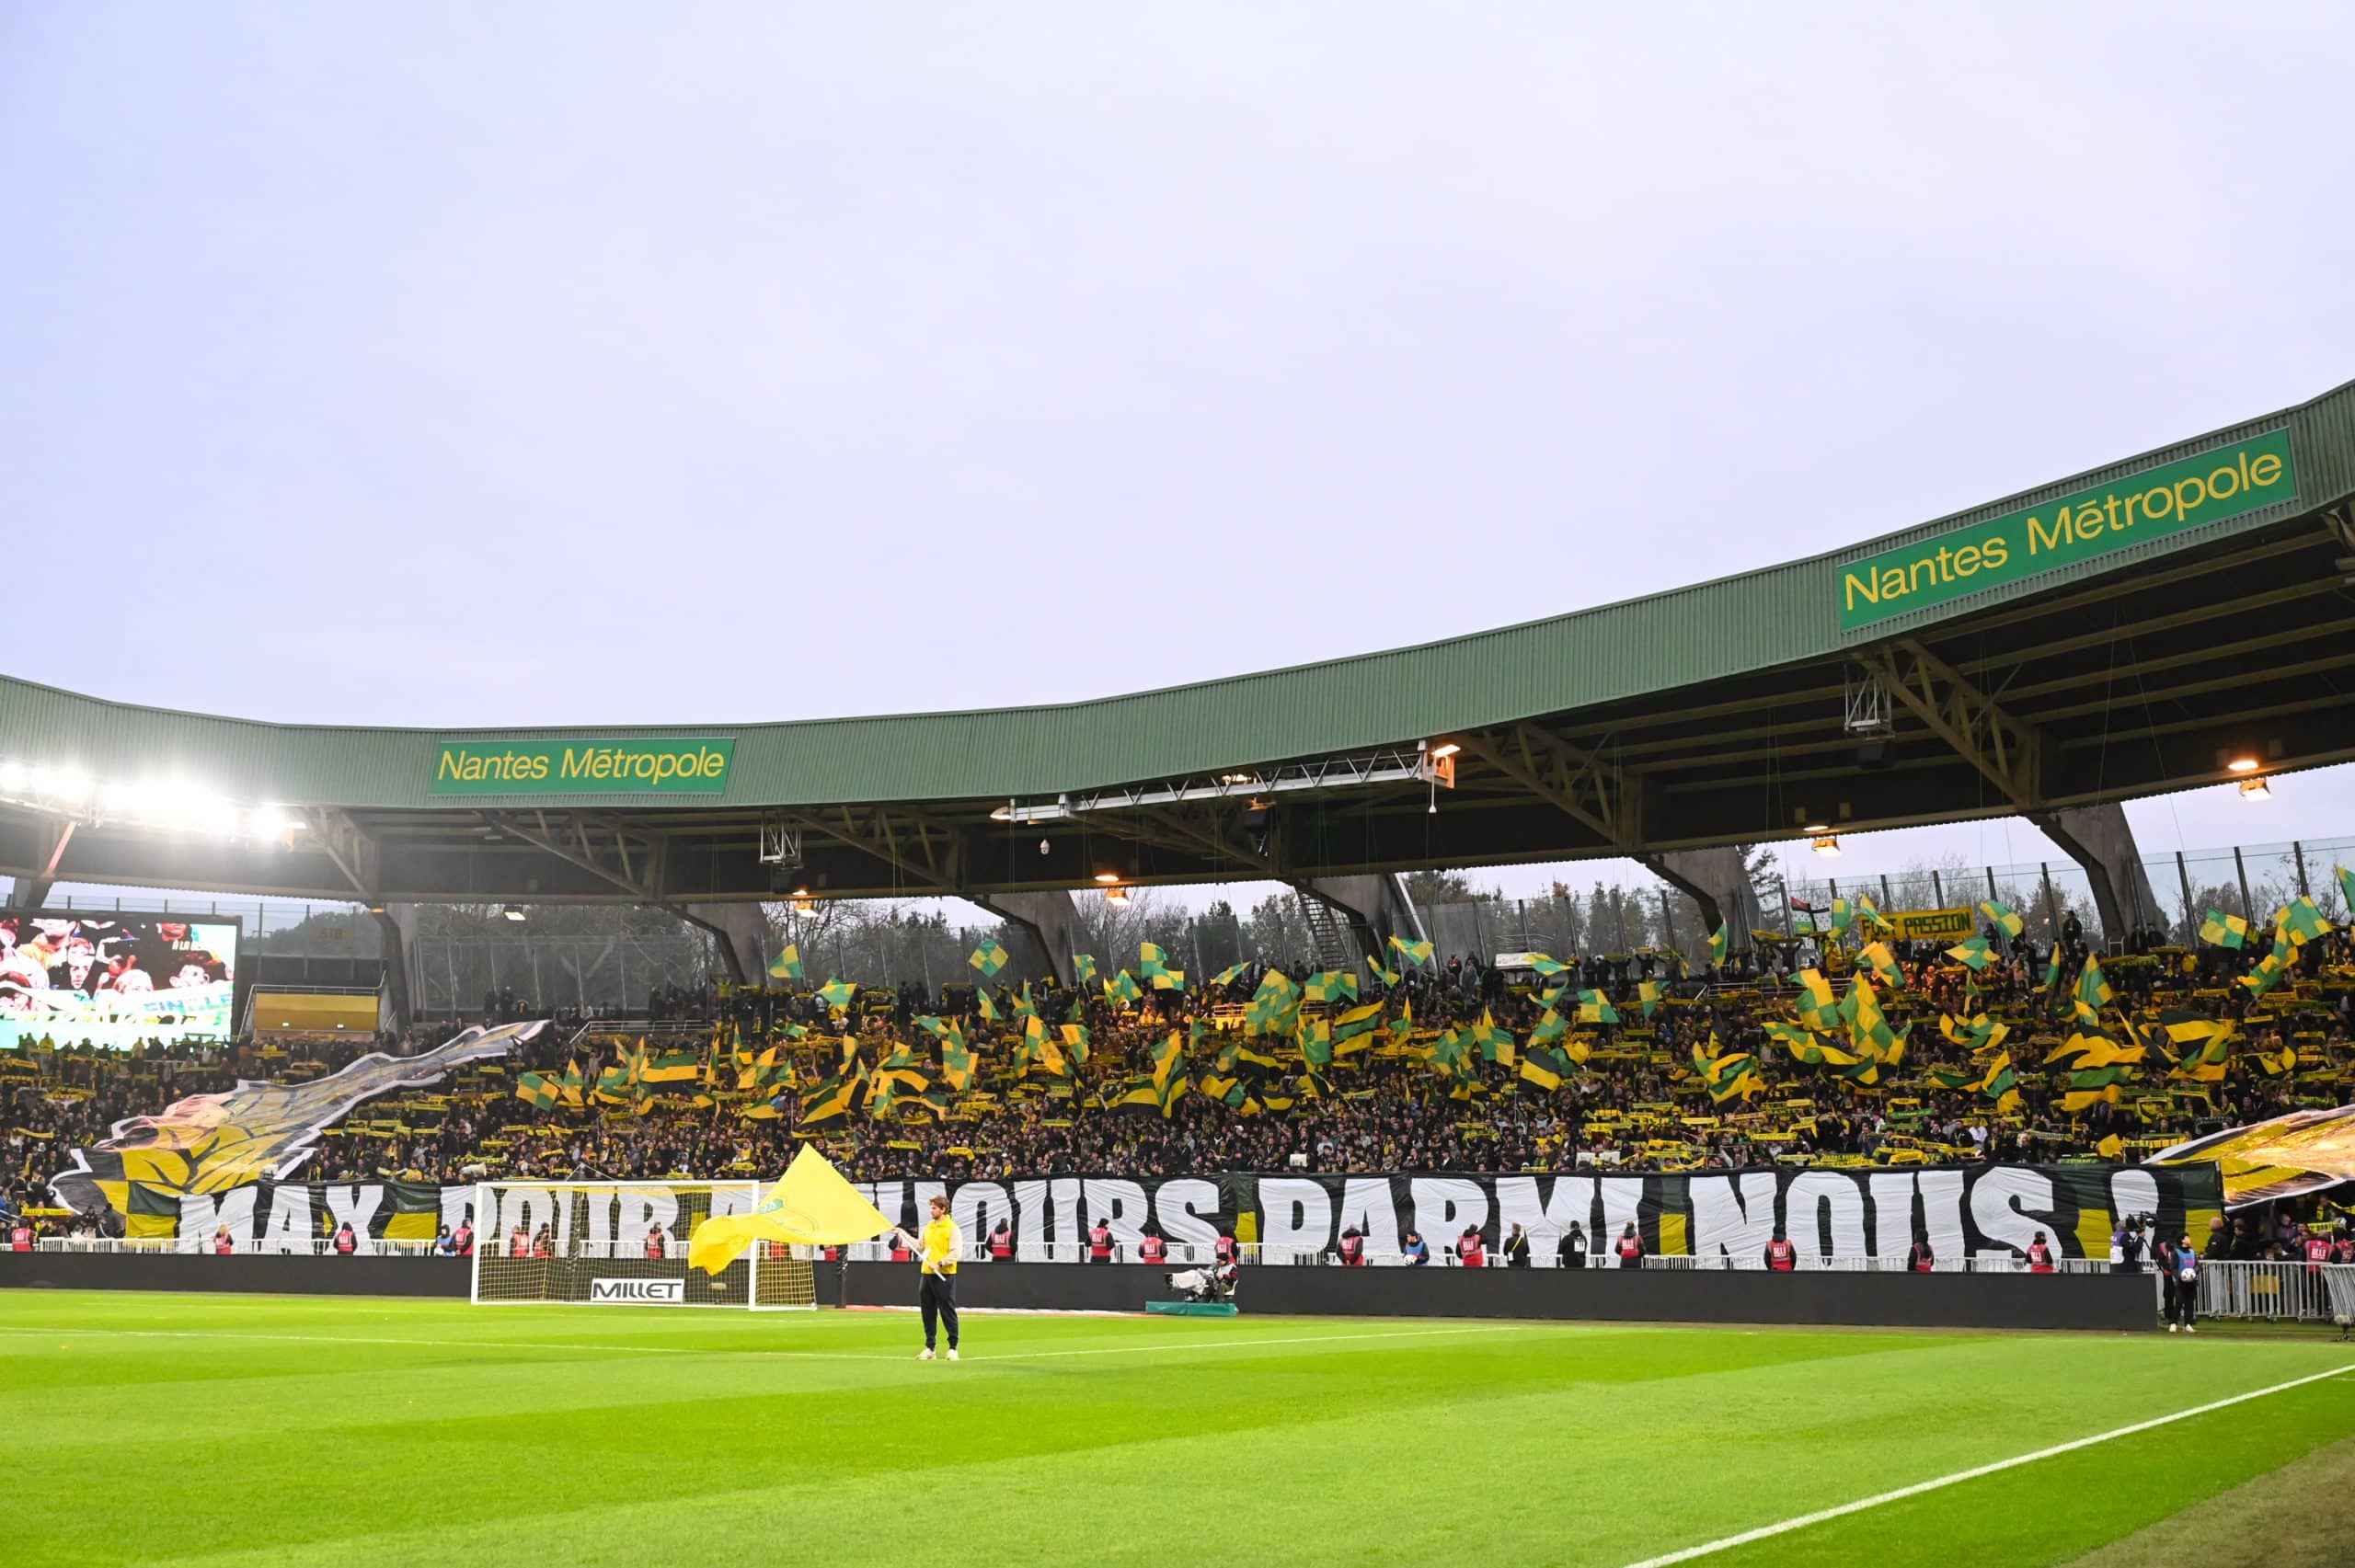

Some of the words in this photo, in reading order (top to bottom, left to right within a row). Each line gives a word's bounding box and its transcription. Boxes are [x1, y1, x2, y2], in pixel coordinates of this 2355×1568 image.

[1844, 536, 2009, 611] Nantes
[438, 750, 549, 780] Nantes
[1903, 911, 1972, 935] PASSION
[178, 1184, 384, 1256] MAX
[1258, 1176, 1644, 1266] PARMI
[1689, 1167, 2063, 1271] NOUS
[592, 1282, 682, 1299] MILLET
